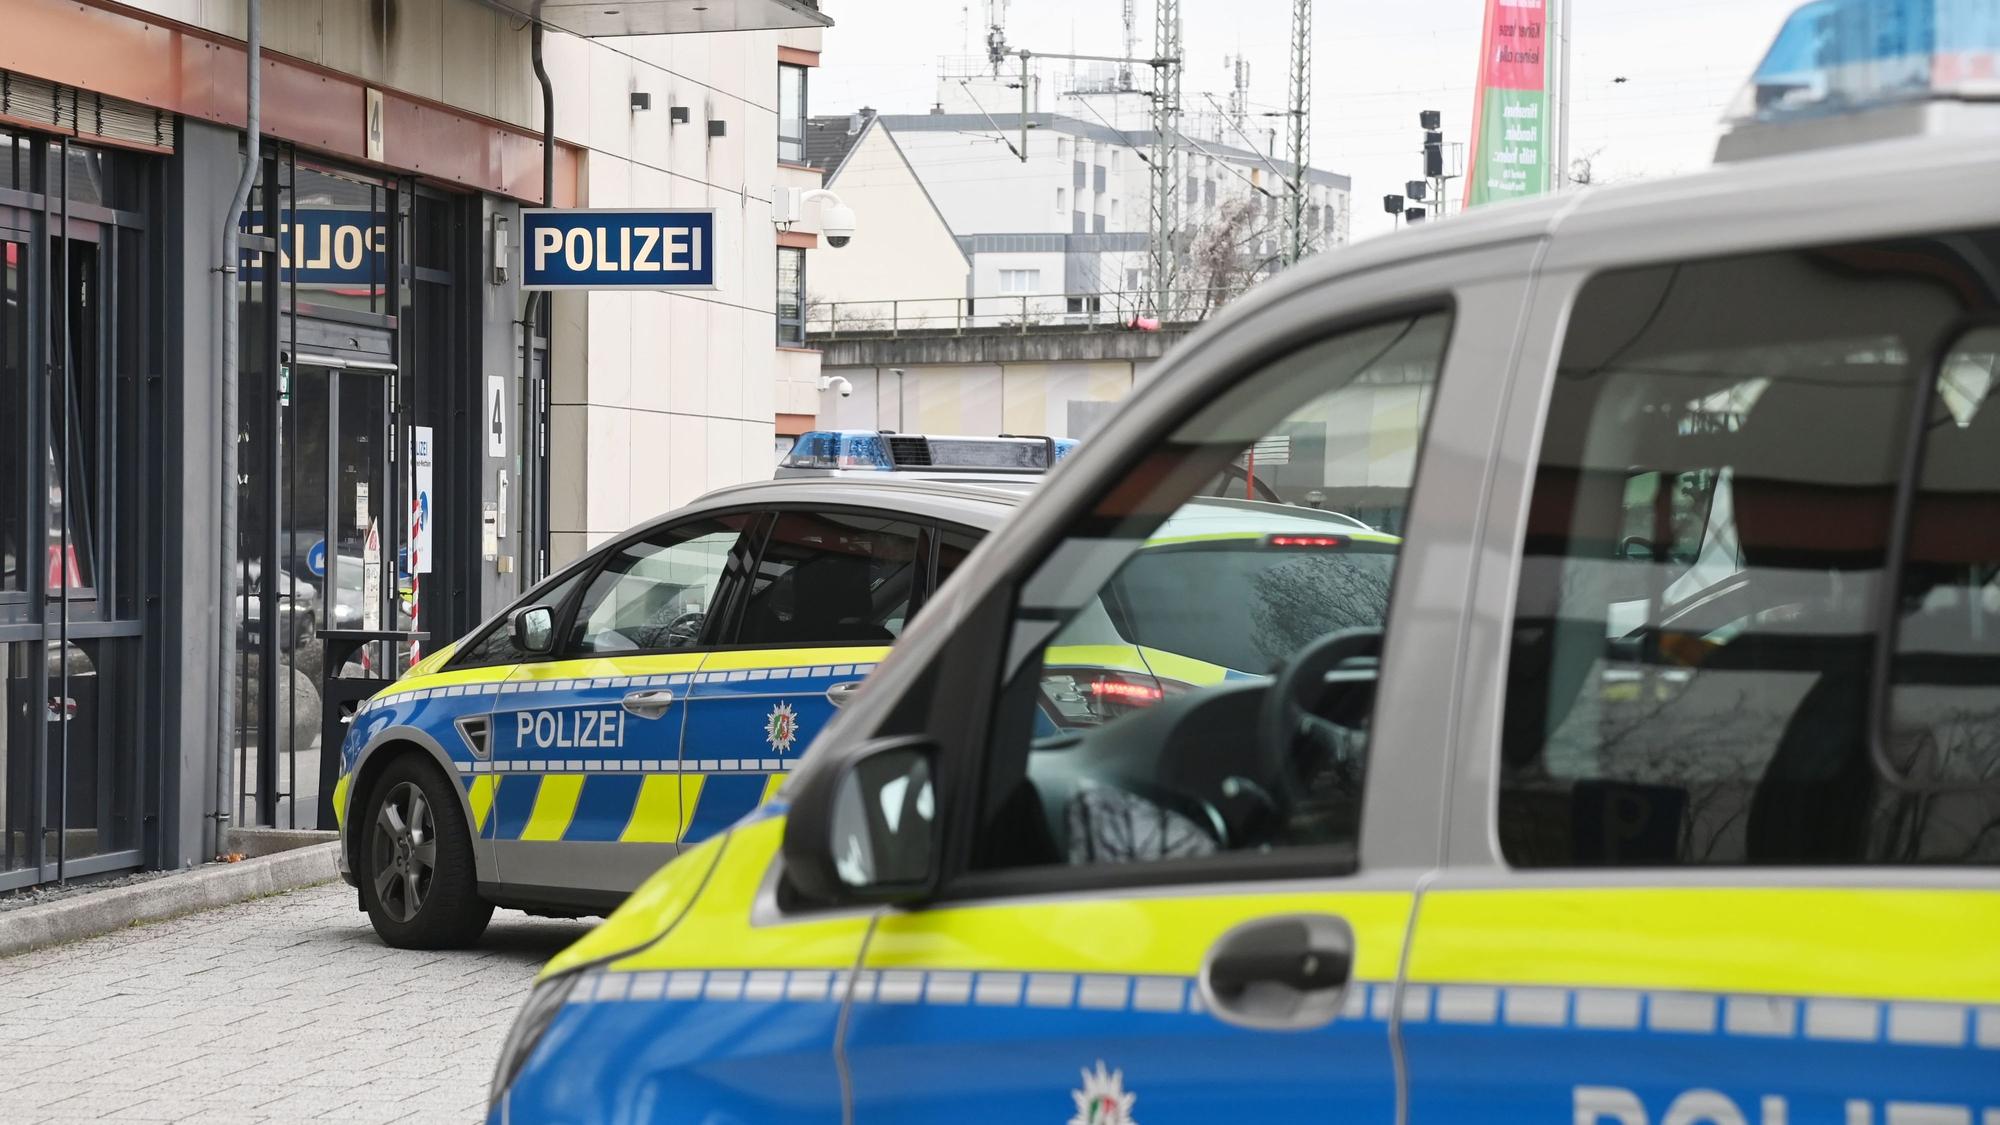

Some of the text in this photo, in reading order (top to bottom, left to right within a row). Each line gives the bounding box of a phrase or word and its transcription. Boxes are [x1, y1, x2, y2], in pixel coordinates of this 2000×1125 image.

[370, 100, 381, 152] 4
[534, 227, 702, 271] POLIZEI
[492, 388, 503, 444] 4
[517, 710, 625, 748] POLIZEI
